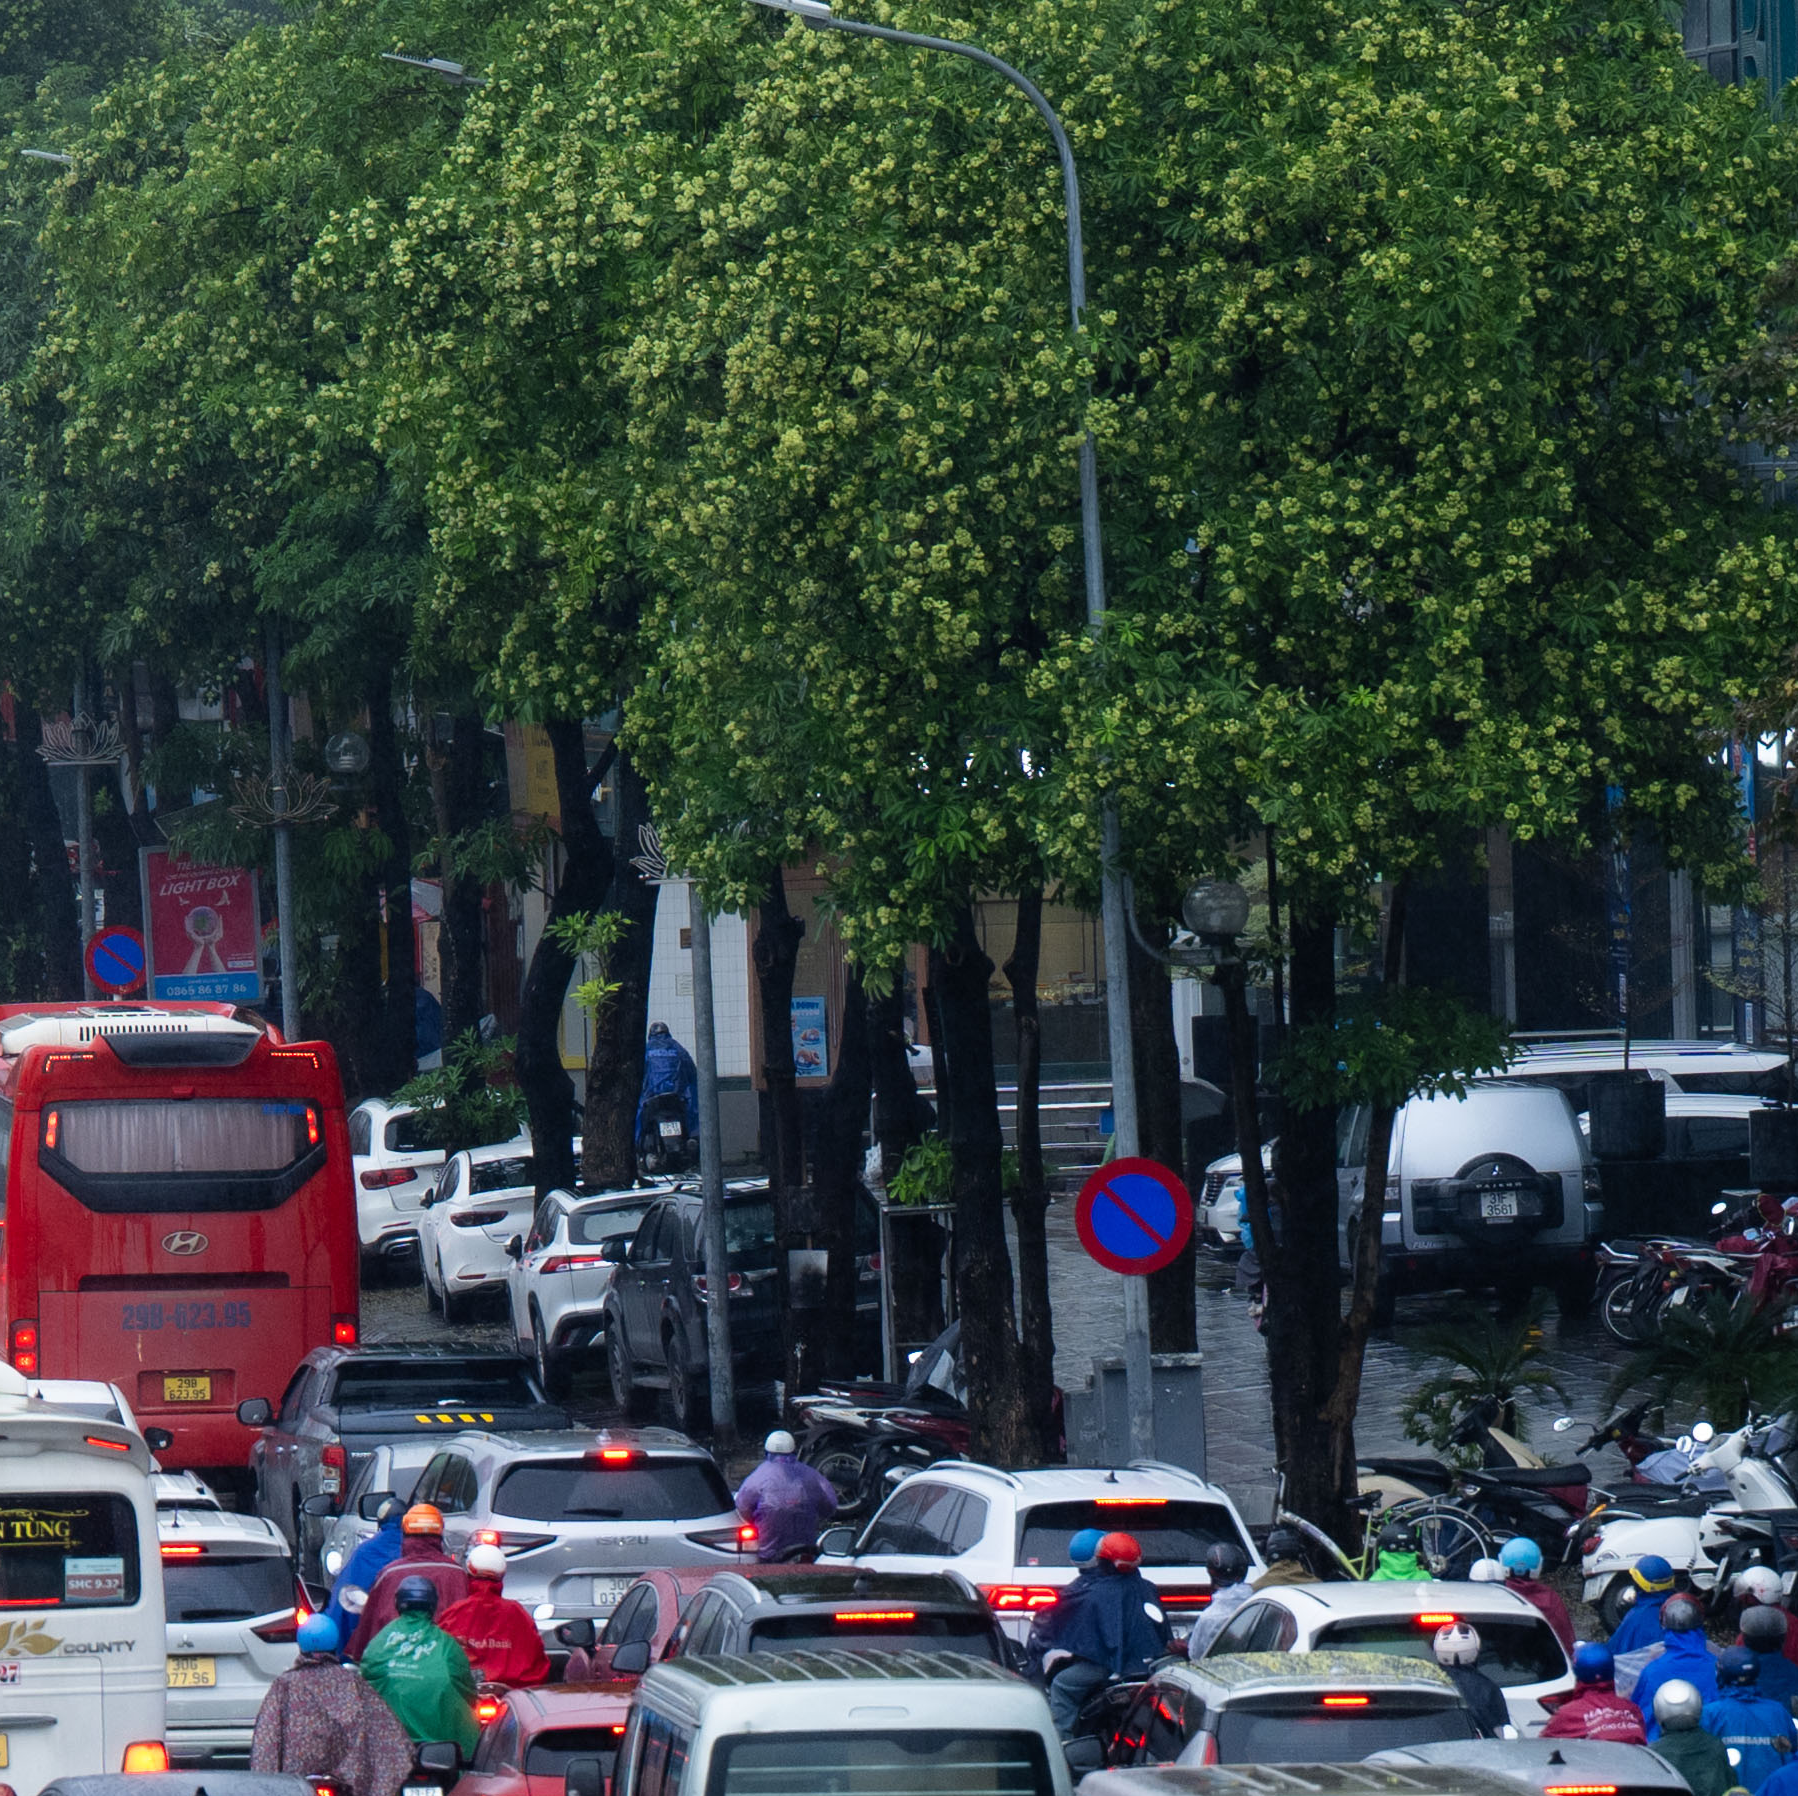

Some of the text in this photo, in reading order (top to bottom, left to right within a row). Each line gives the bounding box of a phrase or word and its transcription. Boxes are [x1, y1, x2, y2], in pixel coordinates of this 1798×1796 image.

[159, 875, 241, 896] LIGHT BOX
[122, 1301, 251, 1330] 29B-623.95
[10, 1516, 71, 1541] TÙNG
[63, 1640, 136, 1654] COUNTY
